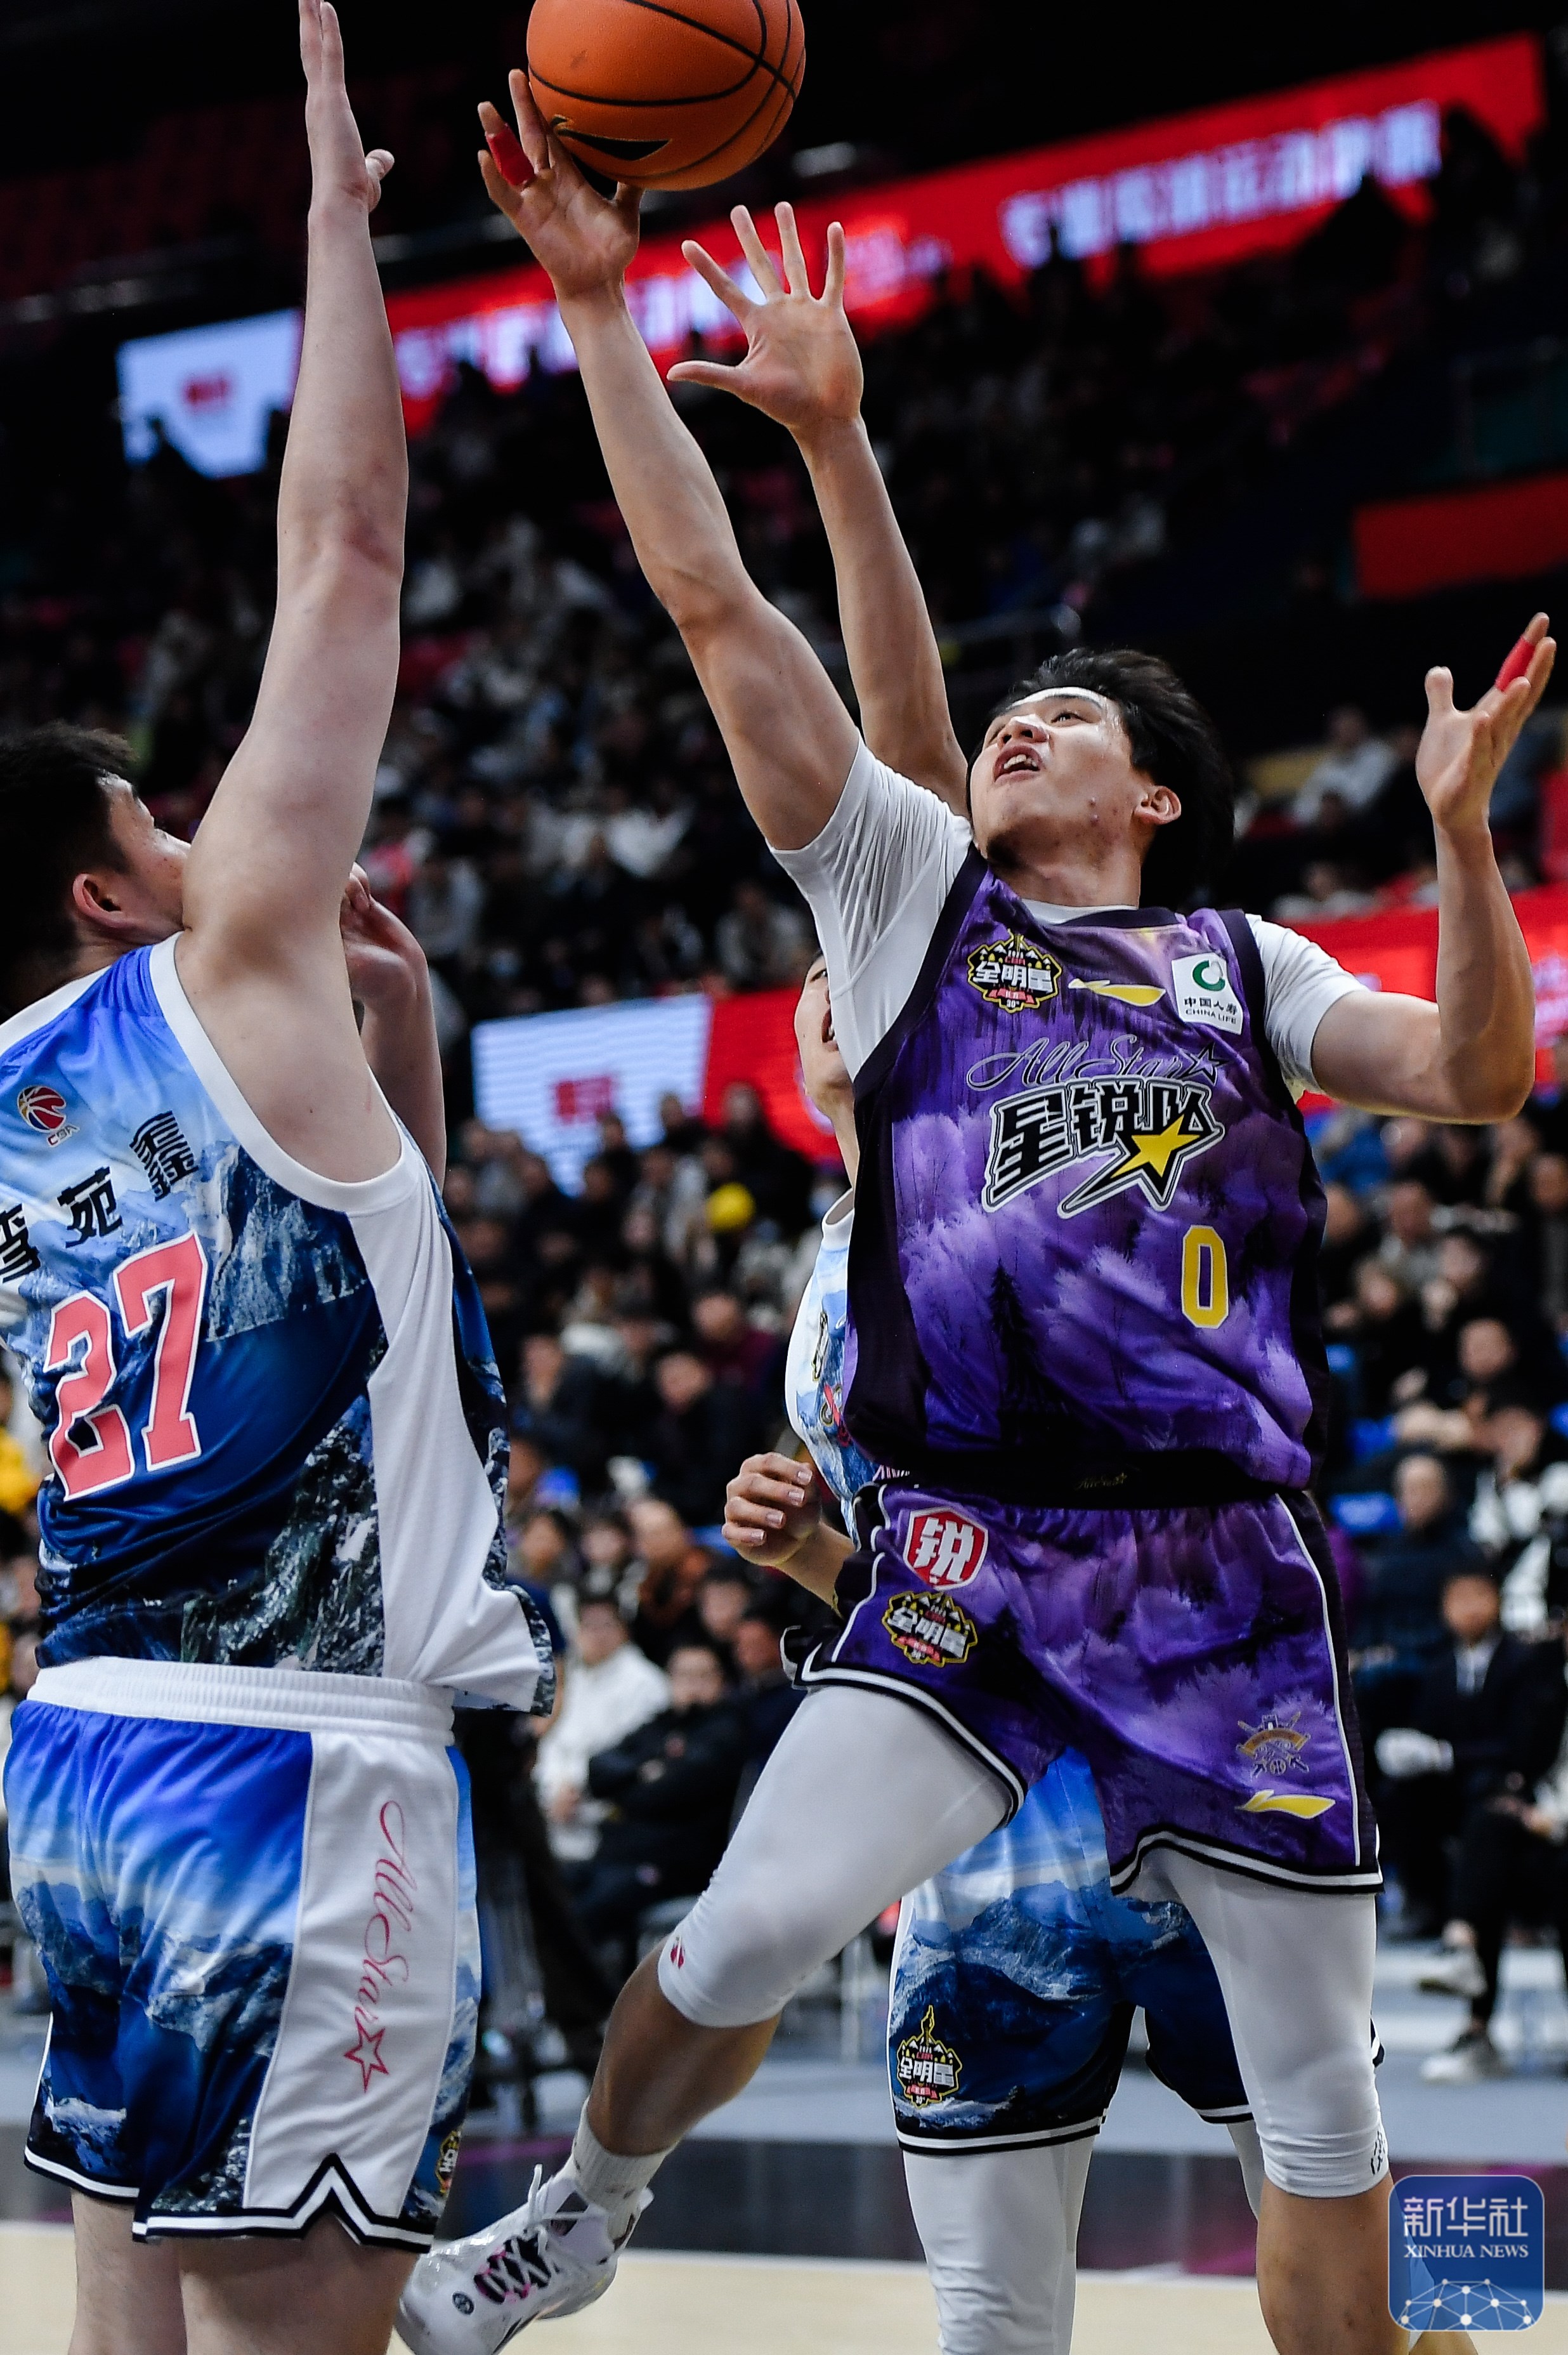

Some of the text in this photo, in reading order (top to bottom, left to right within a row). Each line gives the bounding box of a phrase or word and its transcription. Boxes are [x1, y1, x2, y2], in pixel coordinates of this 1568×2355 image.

[972, 961, 1053, 994] 全明星
[1186, 1009, 1236, 1025] CHINA LIFE
[967, 1034, 1184, 1091] All Star
[47, 1124, 80, 1147] CBA
[982, 1076, 1225, 1218] 星锐队
[1181, 1224, 1229, 1328] 0
[43, 1231, 207, 1501] 27
[913, 1516, 975, 1584] 锐
[355, 1800, 418, 2025] All Star
